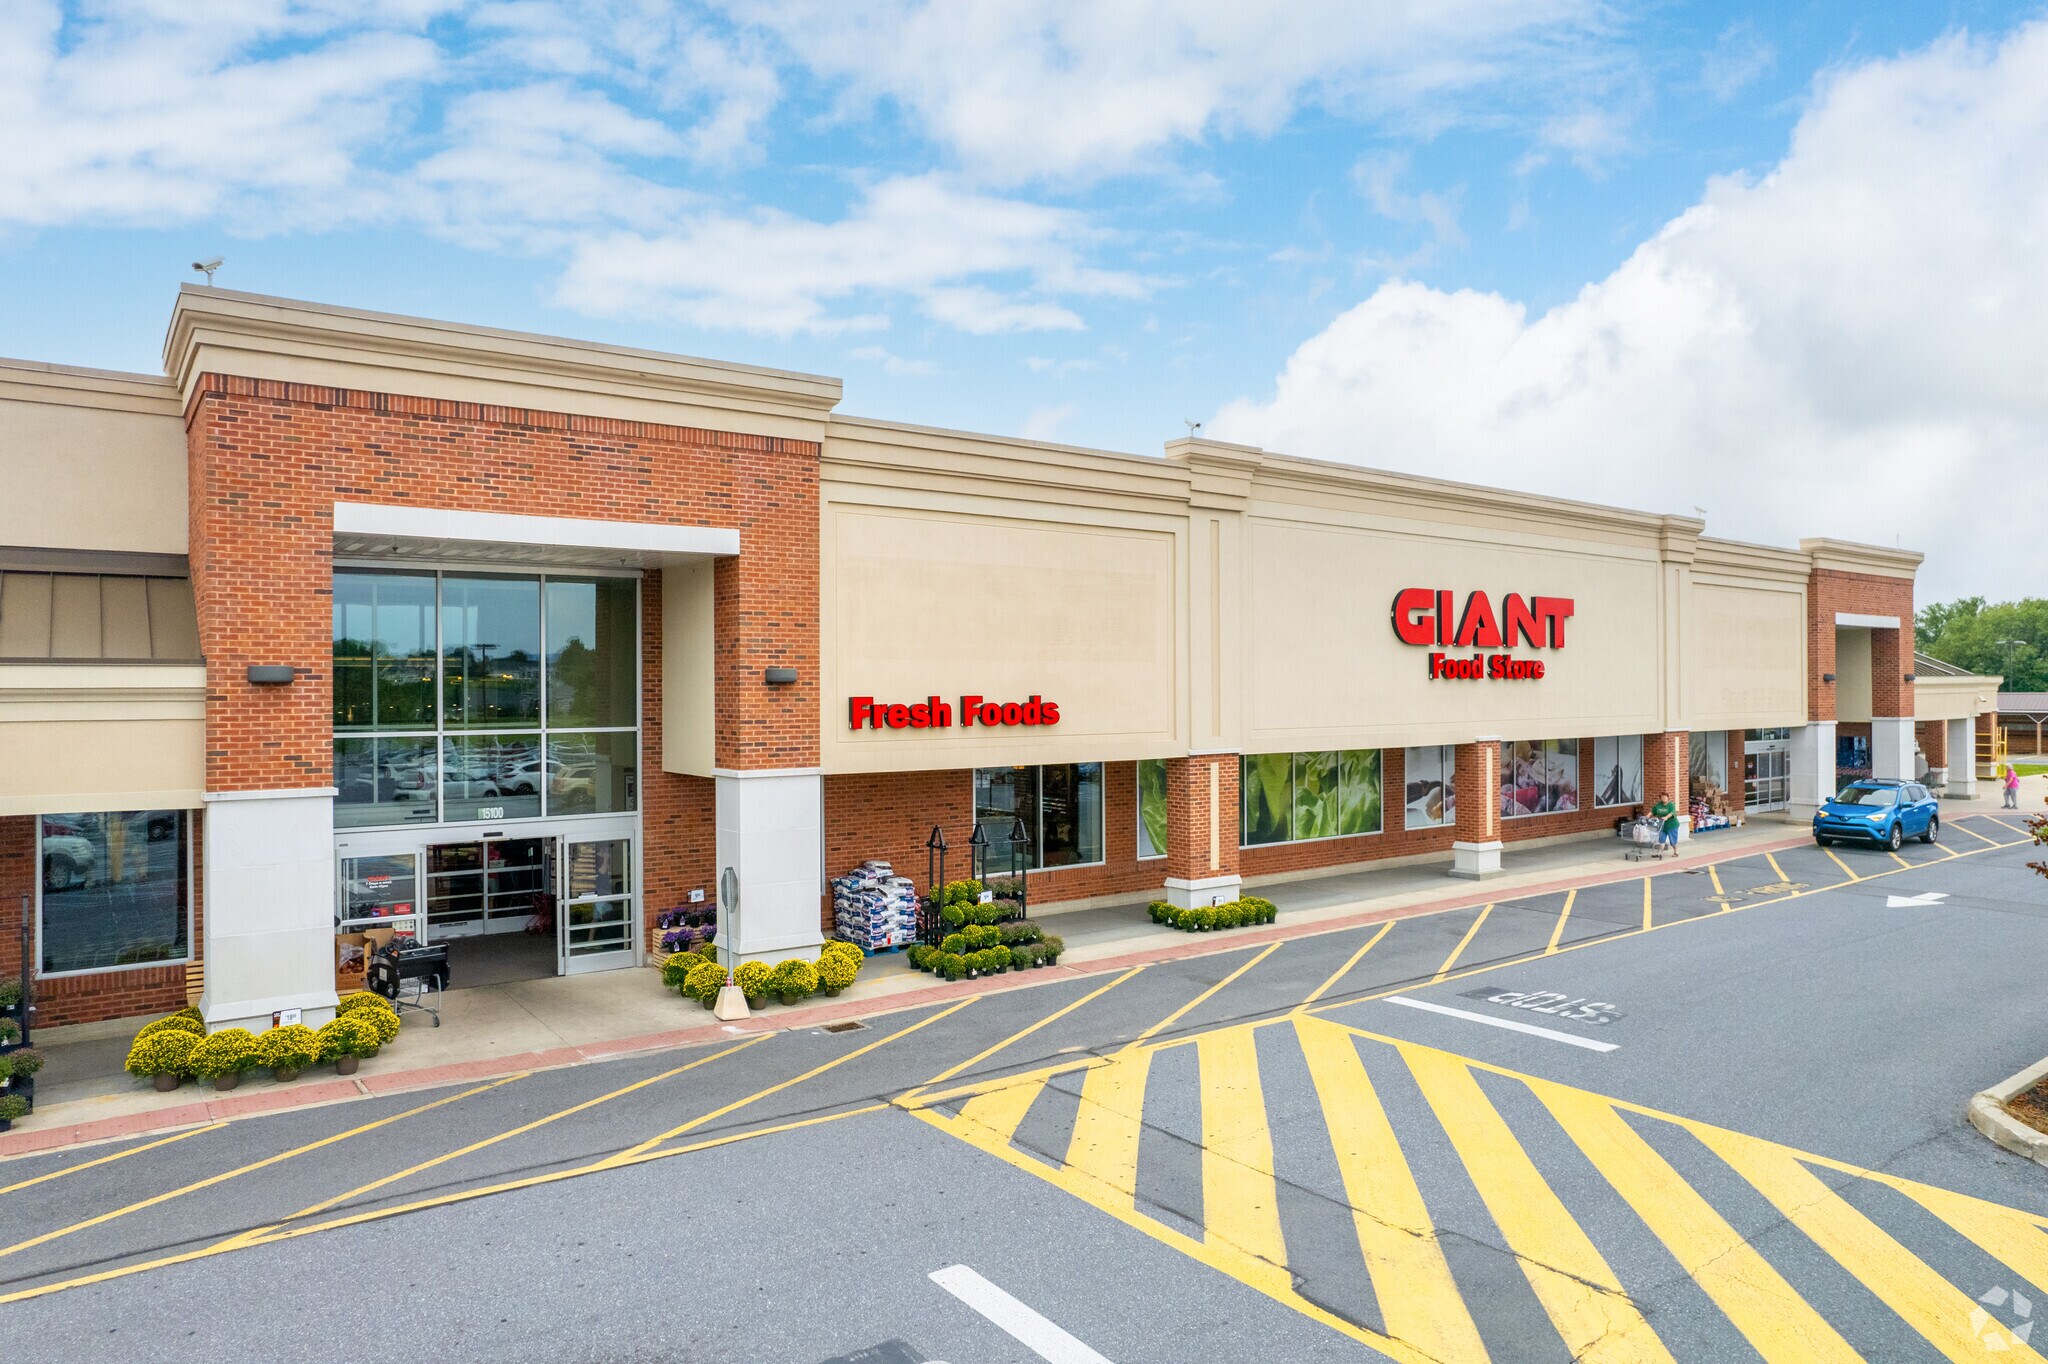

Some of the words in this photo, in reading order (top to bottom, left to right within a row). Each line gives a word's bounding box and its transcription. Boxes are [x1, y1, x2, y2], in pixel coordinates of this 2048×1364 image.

[1391, 588, 1574, 648] GIANT
[1429, 652, 1484, 680] Food
[1487, 654, 1545, 680] Store
[849, 696, 952, 730] Fresh
[960, 695, 1061, 727] Foods
[481, 806, 504, 819] 15100
